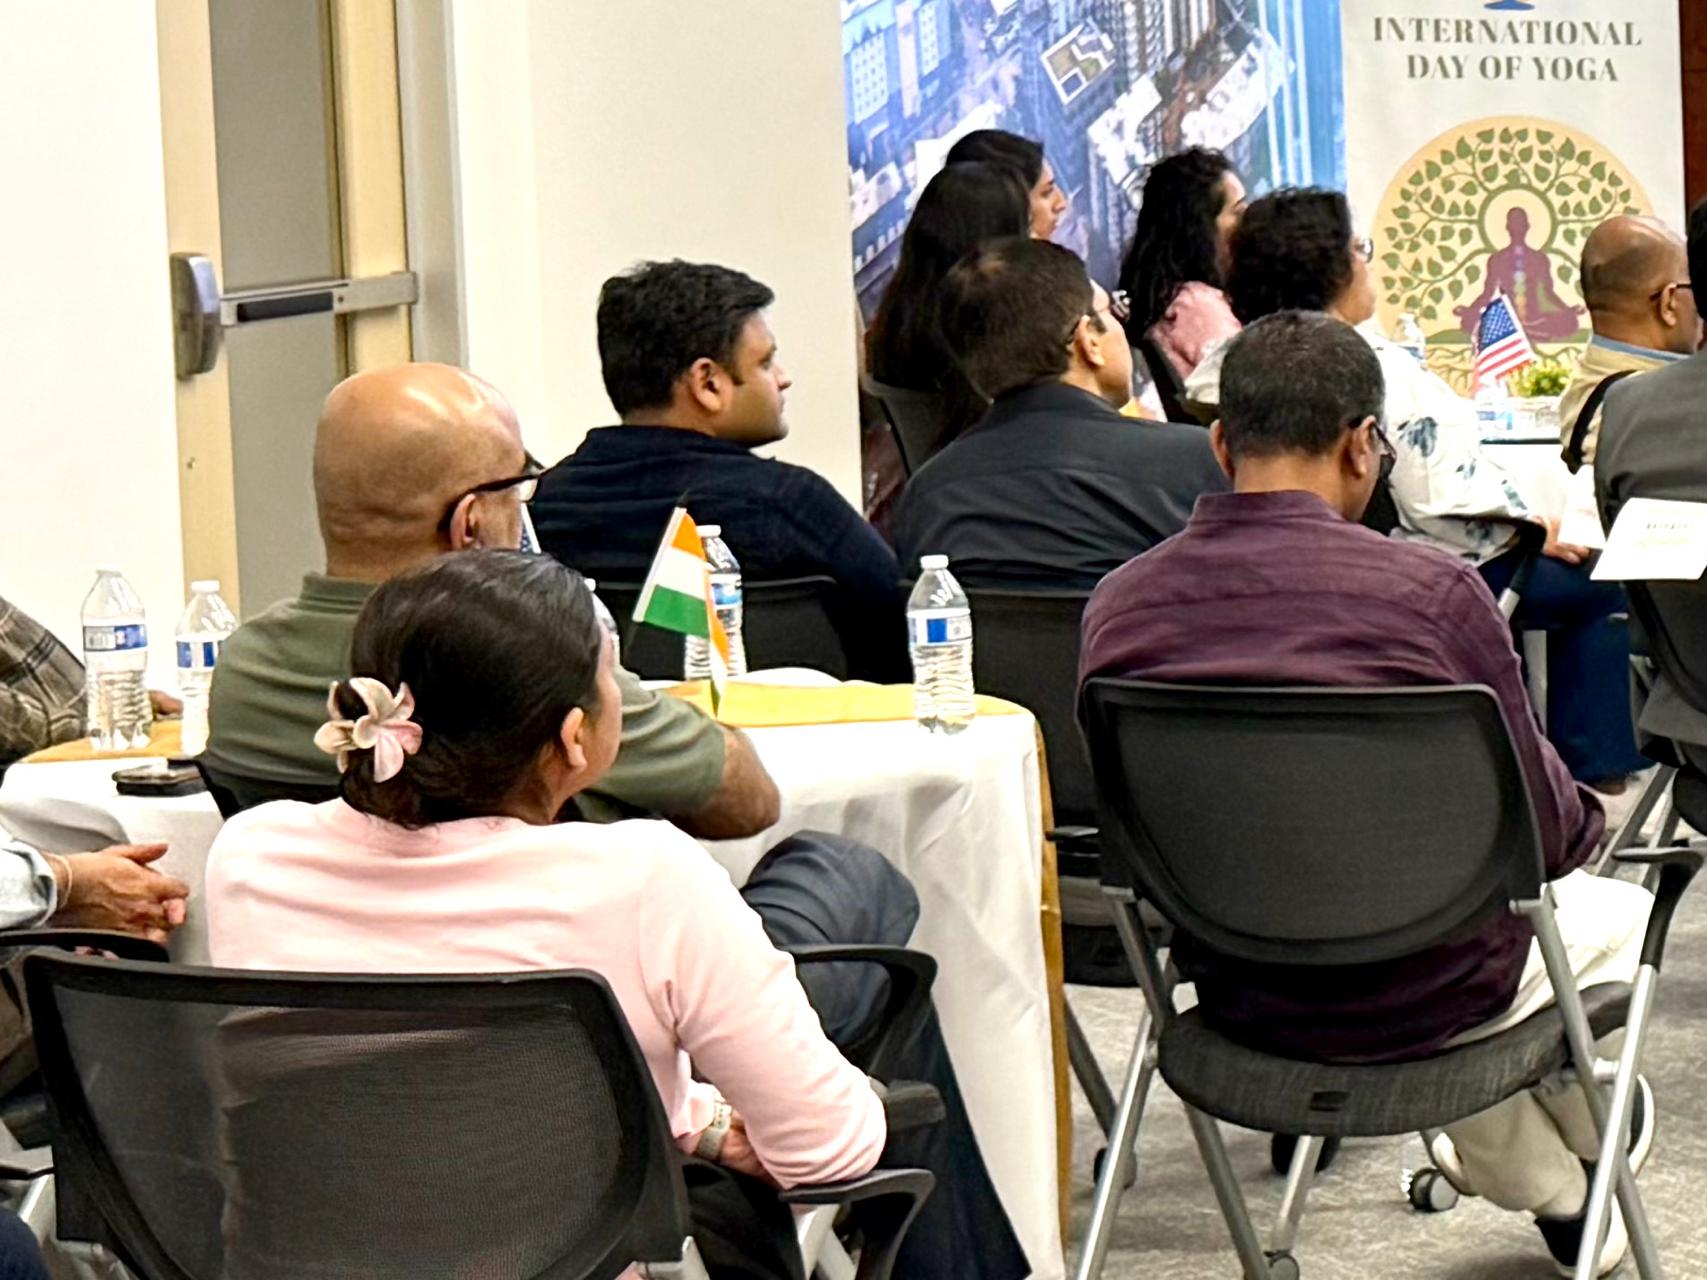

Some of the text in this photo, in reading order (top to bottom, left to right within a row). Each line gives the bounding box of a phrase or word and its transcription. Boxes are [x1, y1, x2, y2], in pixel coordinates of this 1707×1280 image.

[1374, 17, 1642, 46] INTERNATIONAL
[1407, 54, 1619, 82] DAY OF YOGA
